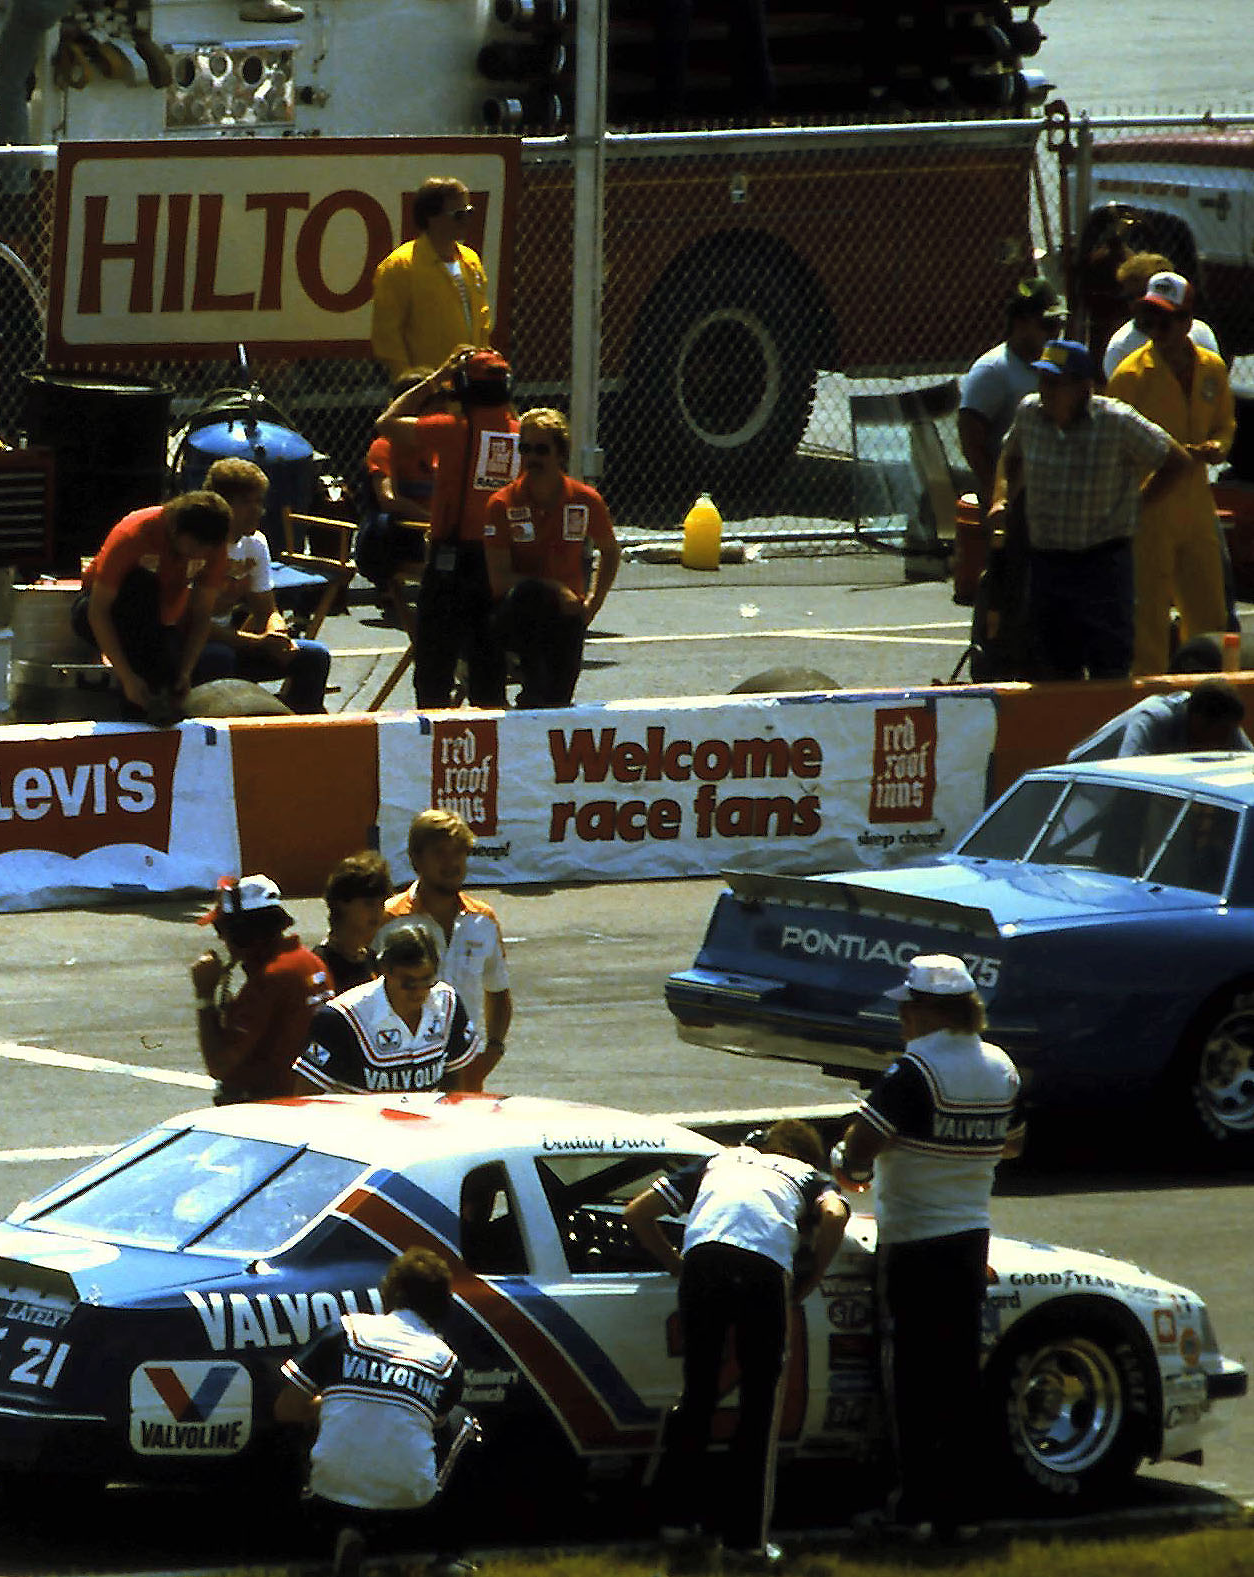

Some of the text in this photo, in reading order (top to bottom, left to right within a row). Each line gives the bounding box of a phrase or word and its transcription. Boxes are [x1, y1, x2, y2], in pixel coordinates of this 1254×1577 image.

[441, 728, 475, 764] red
[883, 715, 915, 750] red
[548, 726, 823, 783] Welcome
[885, 742, 930, 779] roof
[446, 755, 492, 793] roof
[876, 771, 923, 808] inns
[549, 785, 822, 842] race fans
[781, 926, 920, 968] PONTIAC
[1010, 1260, 1115, 1288] GOODYEAR
[9, 1337, 71, 1389] 21
[140, 1419, 243, 1450] VALVOLINE
